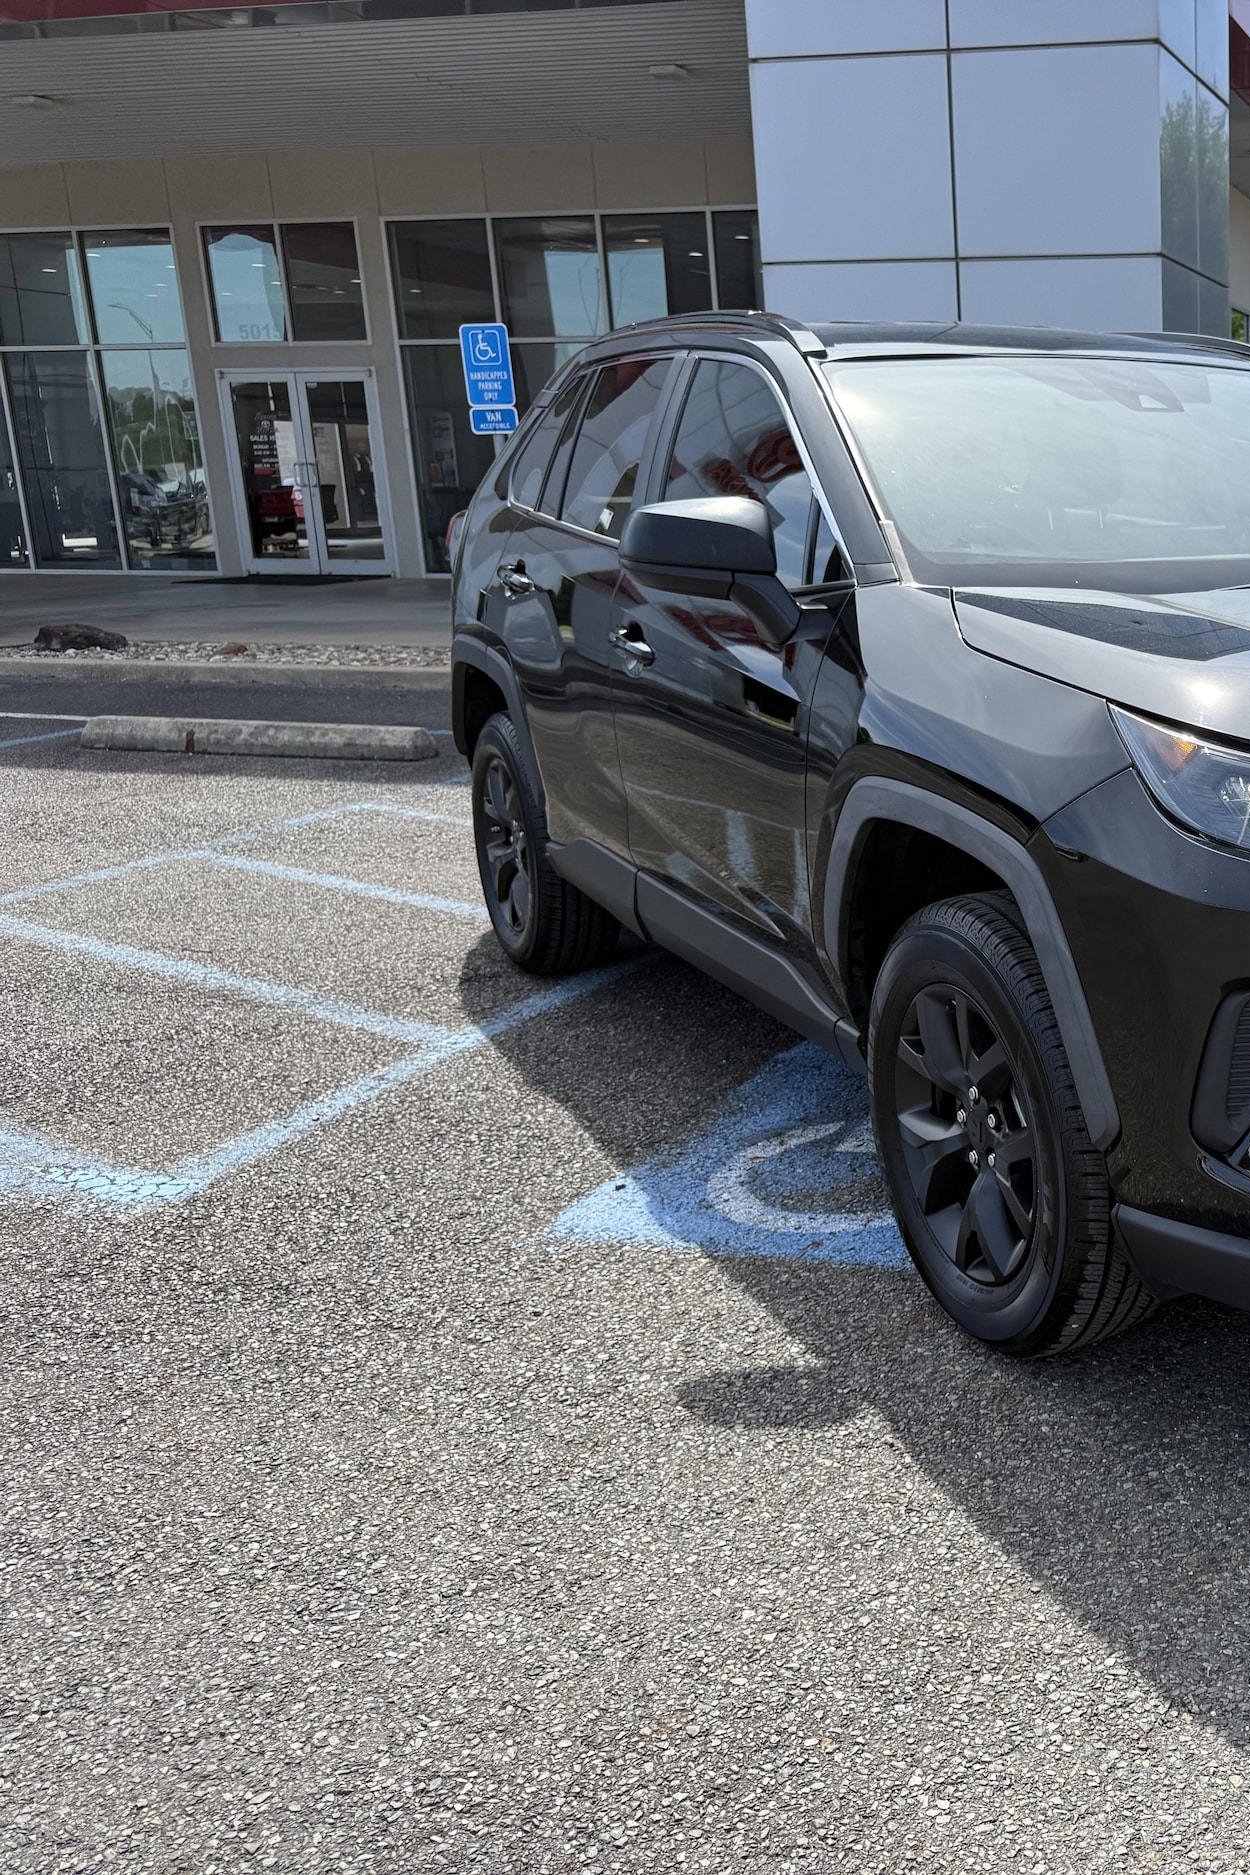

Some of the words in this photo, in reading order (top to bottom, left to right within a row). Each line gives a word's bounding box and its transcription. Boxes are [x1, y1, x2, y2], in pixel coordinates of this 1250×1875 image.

[470, 371, 508, 380] HANDICAPPED
[478, 381, 503, 390] PARKING
[484, 391, 498, 401] ONLY
[485, 411, 502, 422] VAN
[250, 434, 268, 442] SALES
